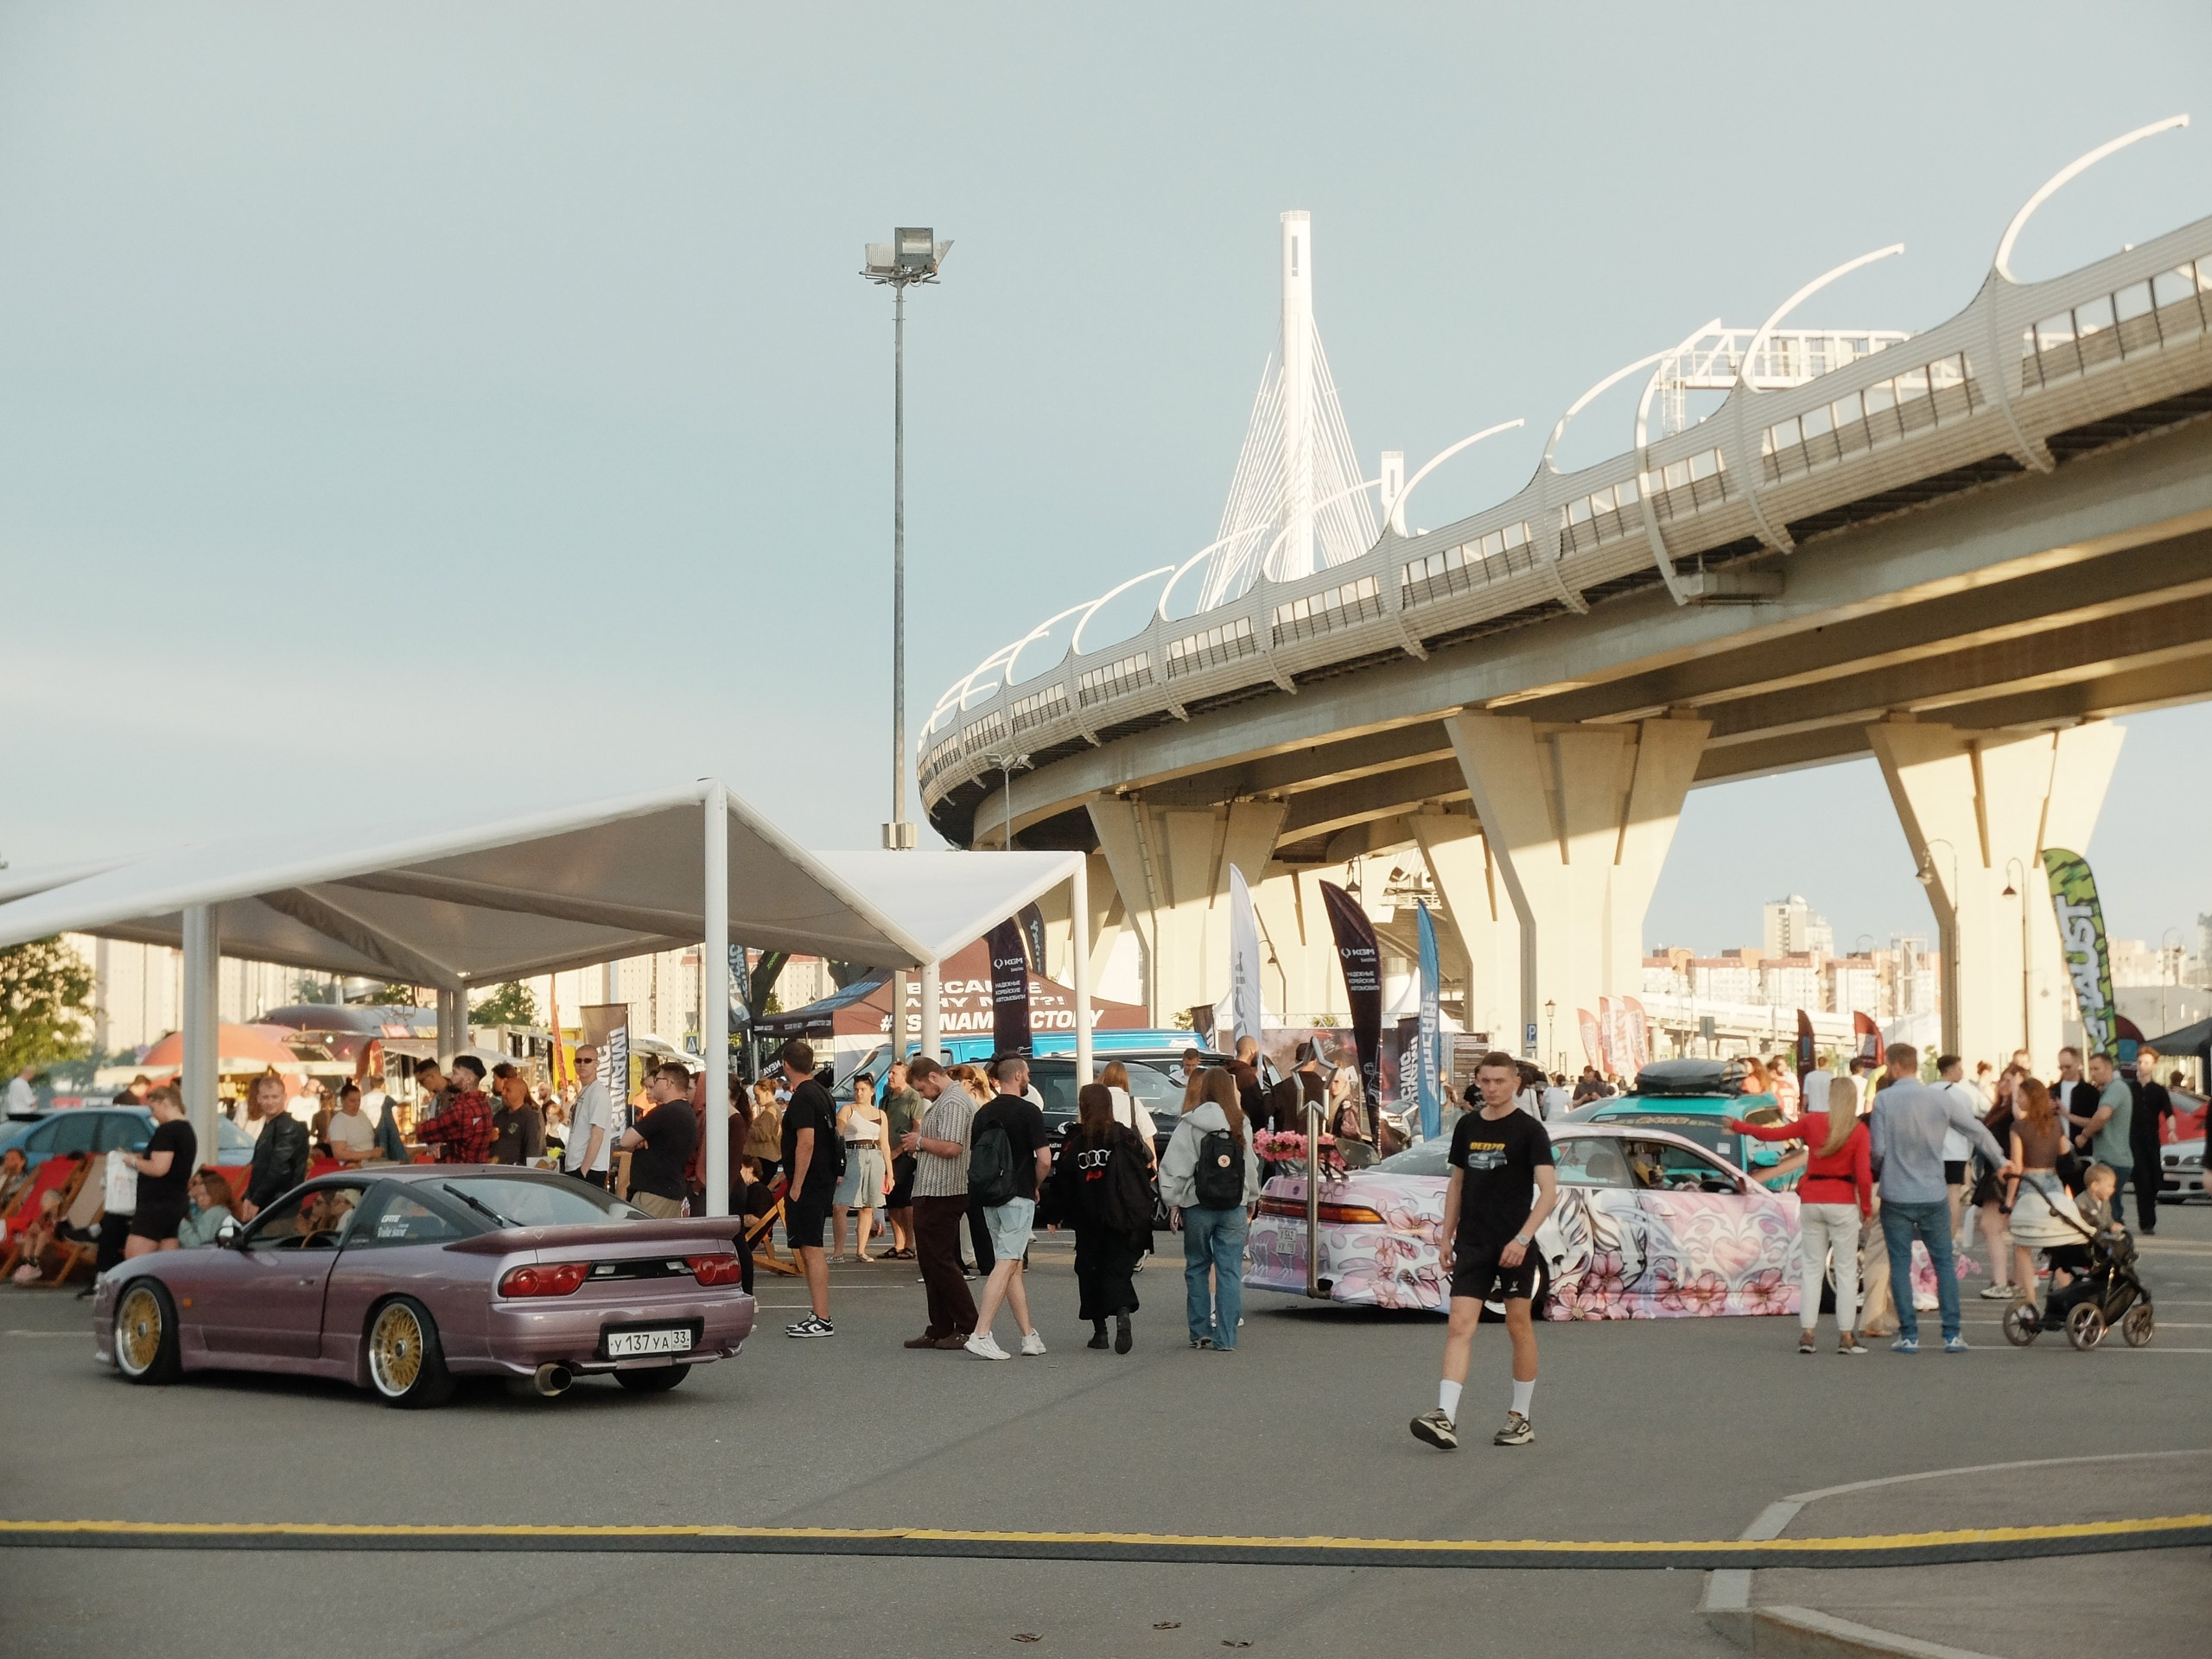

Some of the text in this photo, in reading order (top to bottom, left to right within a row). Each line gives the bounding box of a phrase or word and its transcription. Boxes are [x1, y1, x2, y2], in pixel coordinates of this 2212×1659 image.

[1004, 957, 1023, 966] KGM
[1529, 1025, 1536, 1040] P
[674, 1331, 686, 1344] 33
